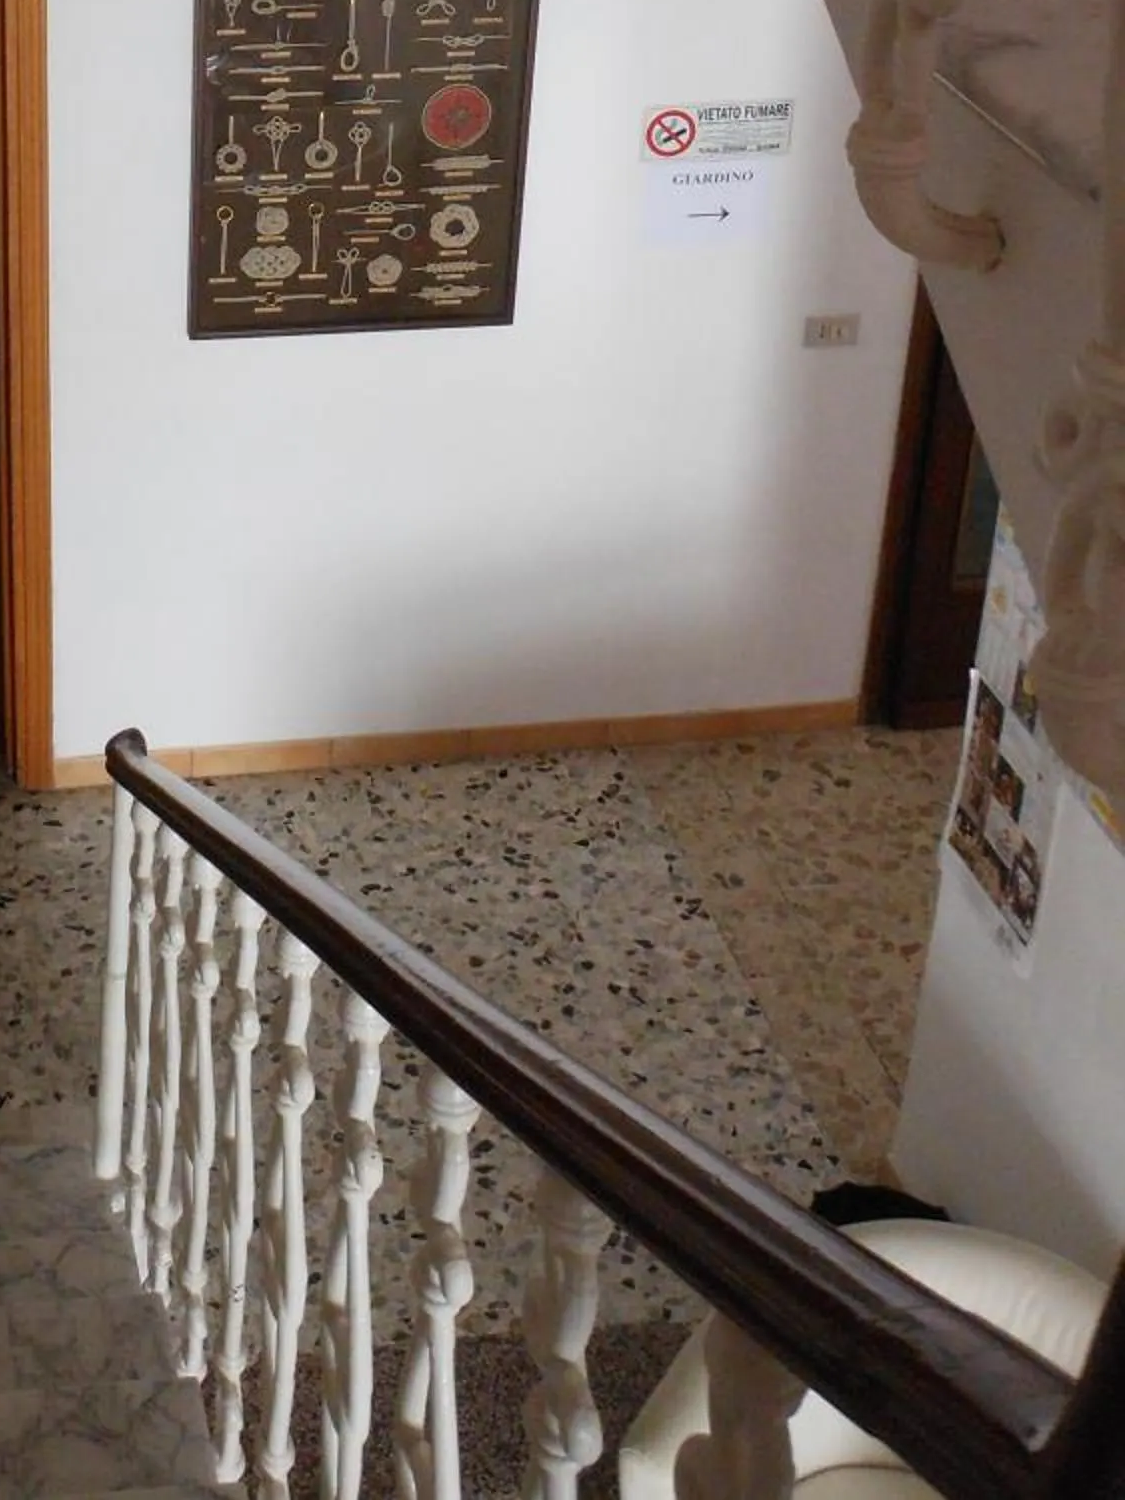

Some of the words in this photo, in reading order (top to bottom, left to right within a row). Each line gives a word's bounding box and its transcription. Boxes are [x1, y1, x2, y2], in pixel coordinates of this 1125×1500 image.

[697, 106, 741, 121] VIETATO
[744, 103, 790, 118] FUMARE
[672, 170, 754, 186] GIARDINO
